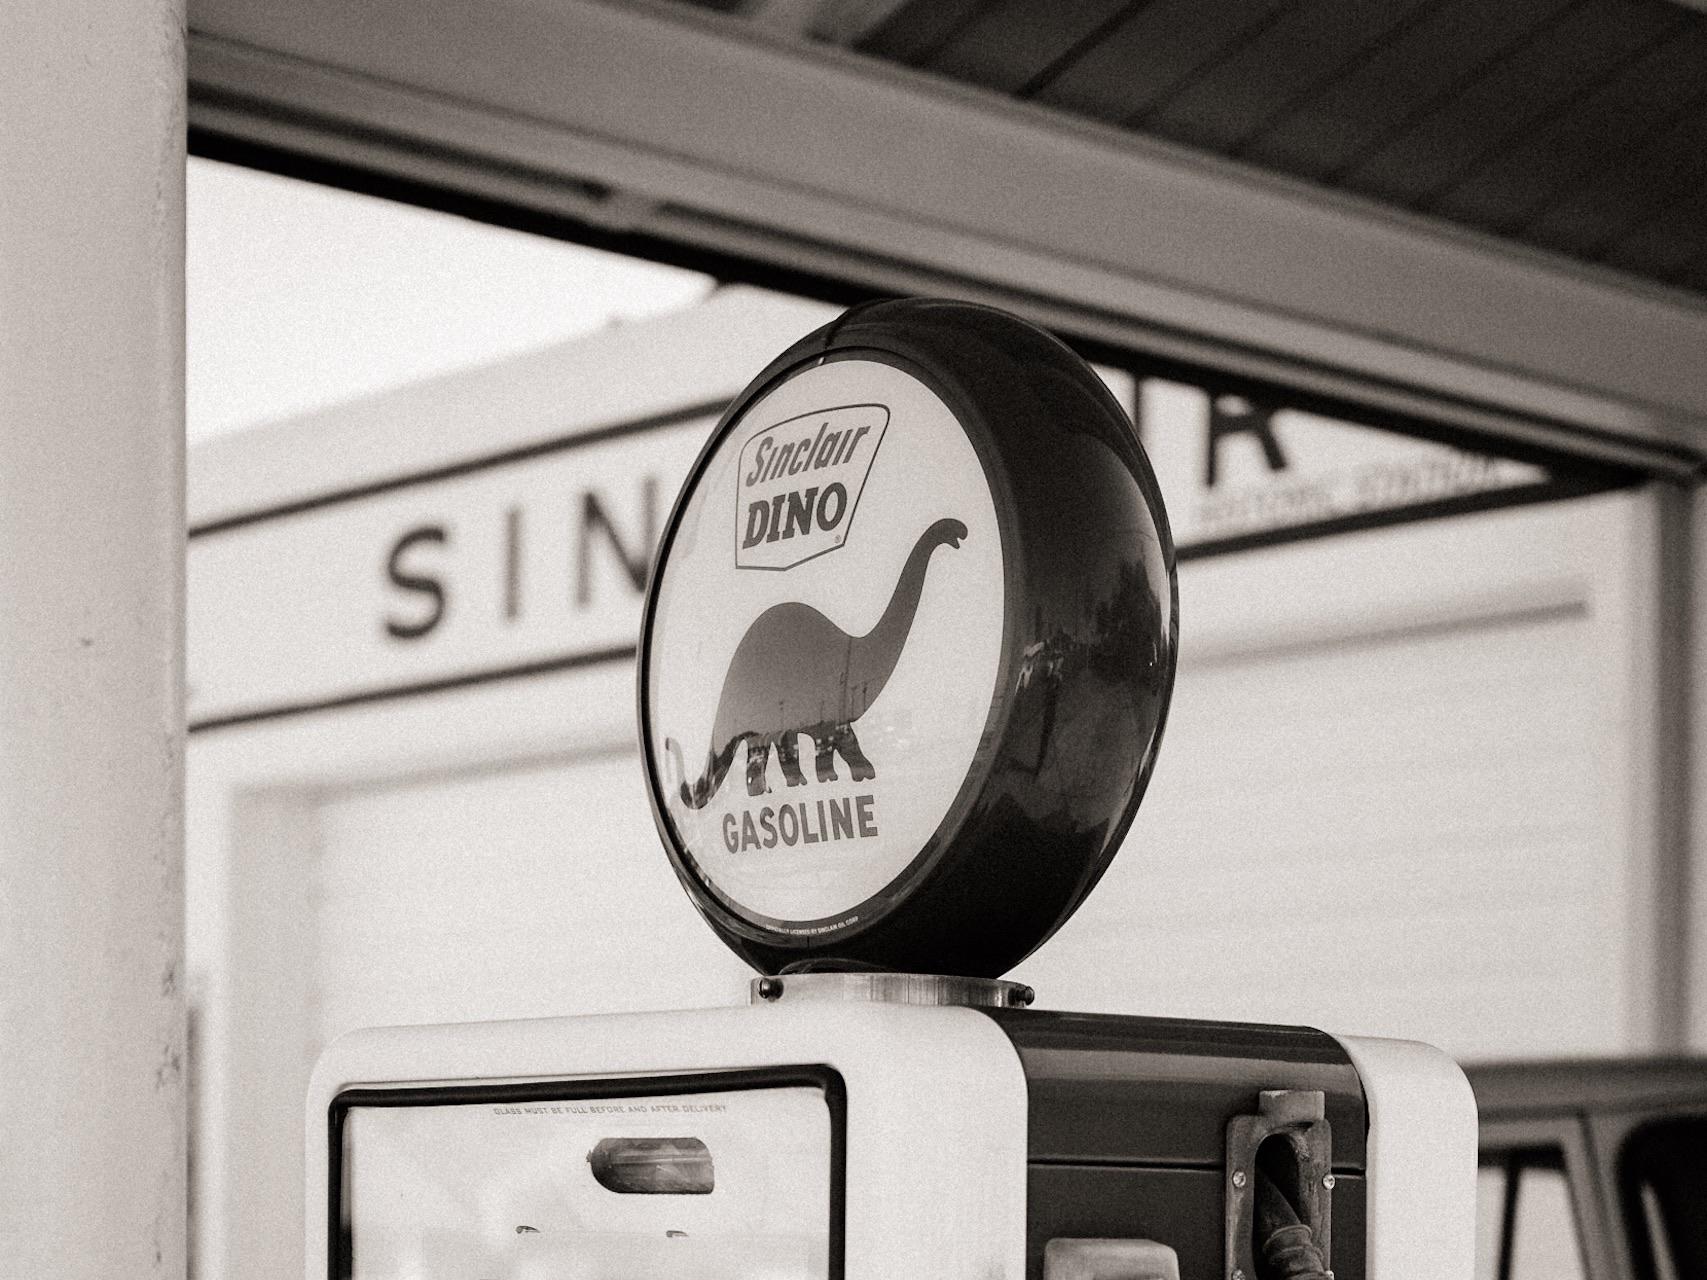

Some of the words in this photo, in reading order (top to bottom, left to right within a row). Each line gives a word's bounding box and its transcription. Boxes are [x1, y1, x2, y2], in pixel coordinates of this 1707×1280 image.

[745, 422, 871, 487] Sinclair
[742, 481, 848, 549] DINO
[722, 794, 879, 854] GASOLINE
